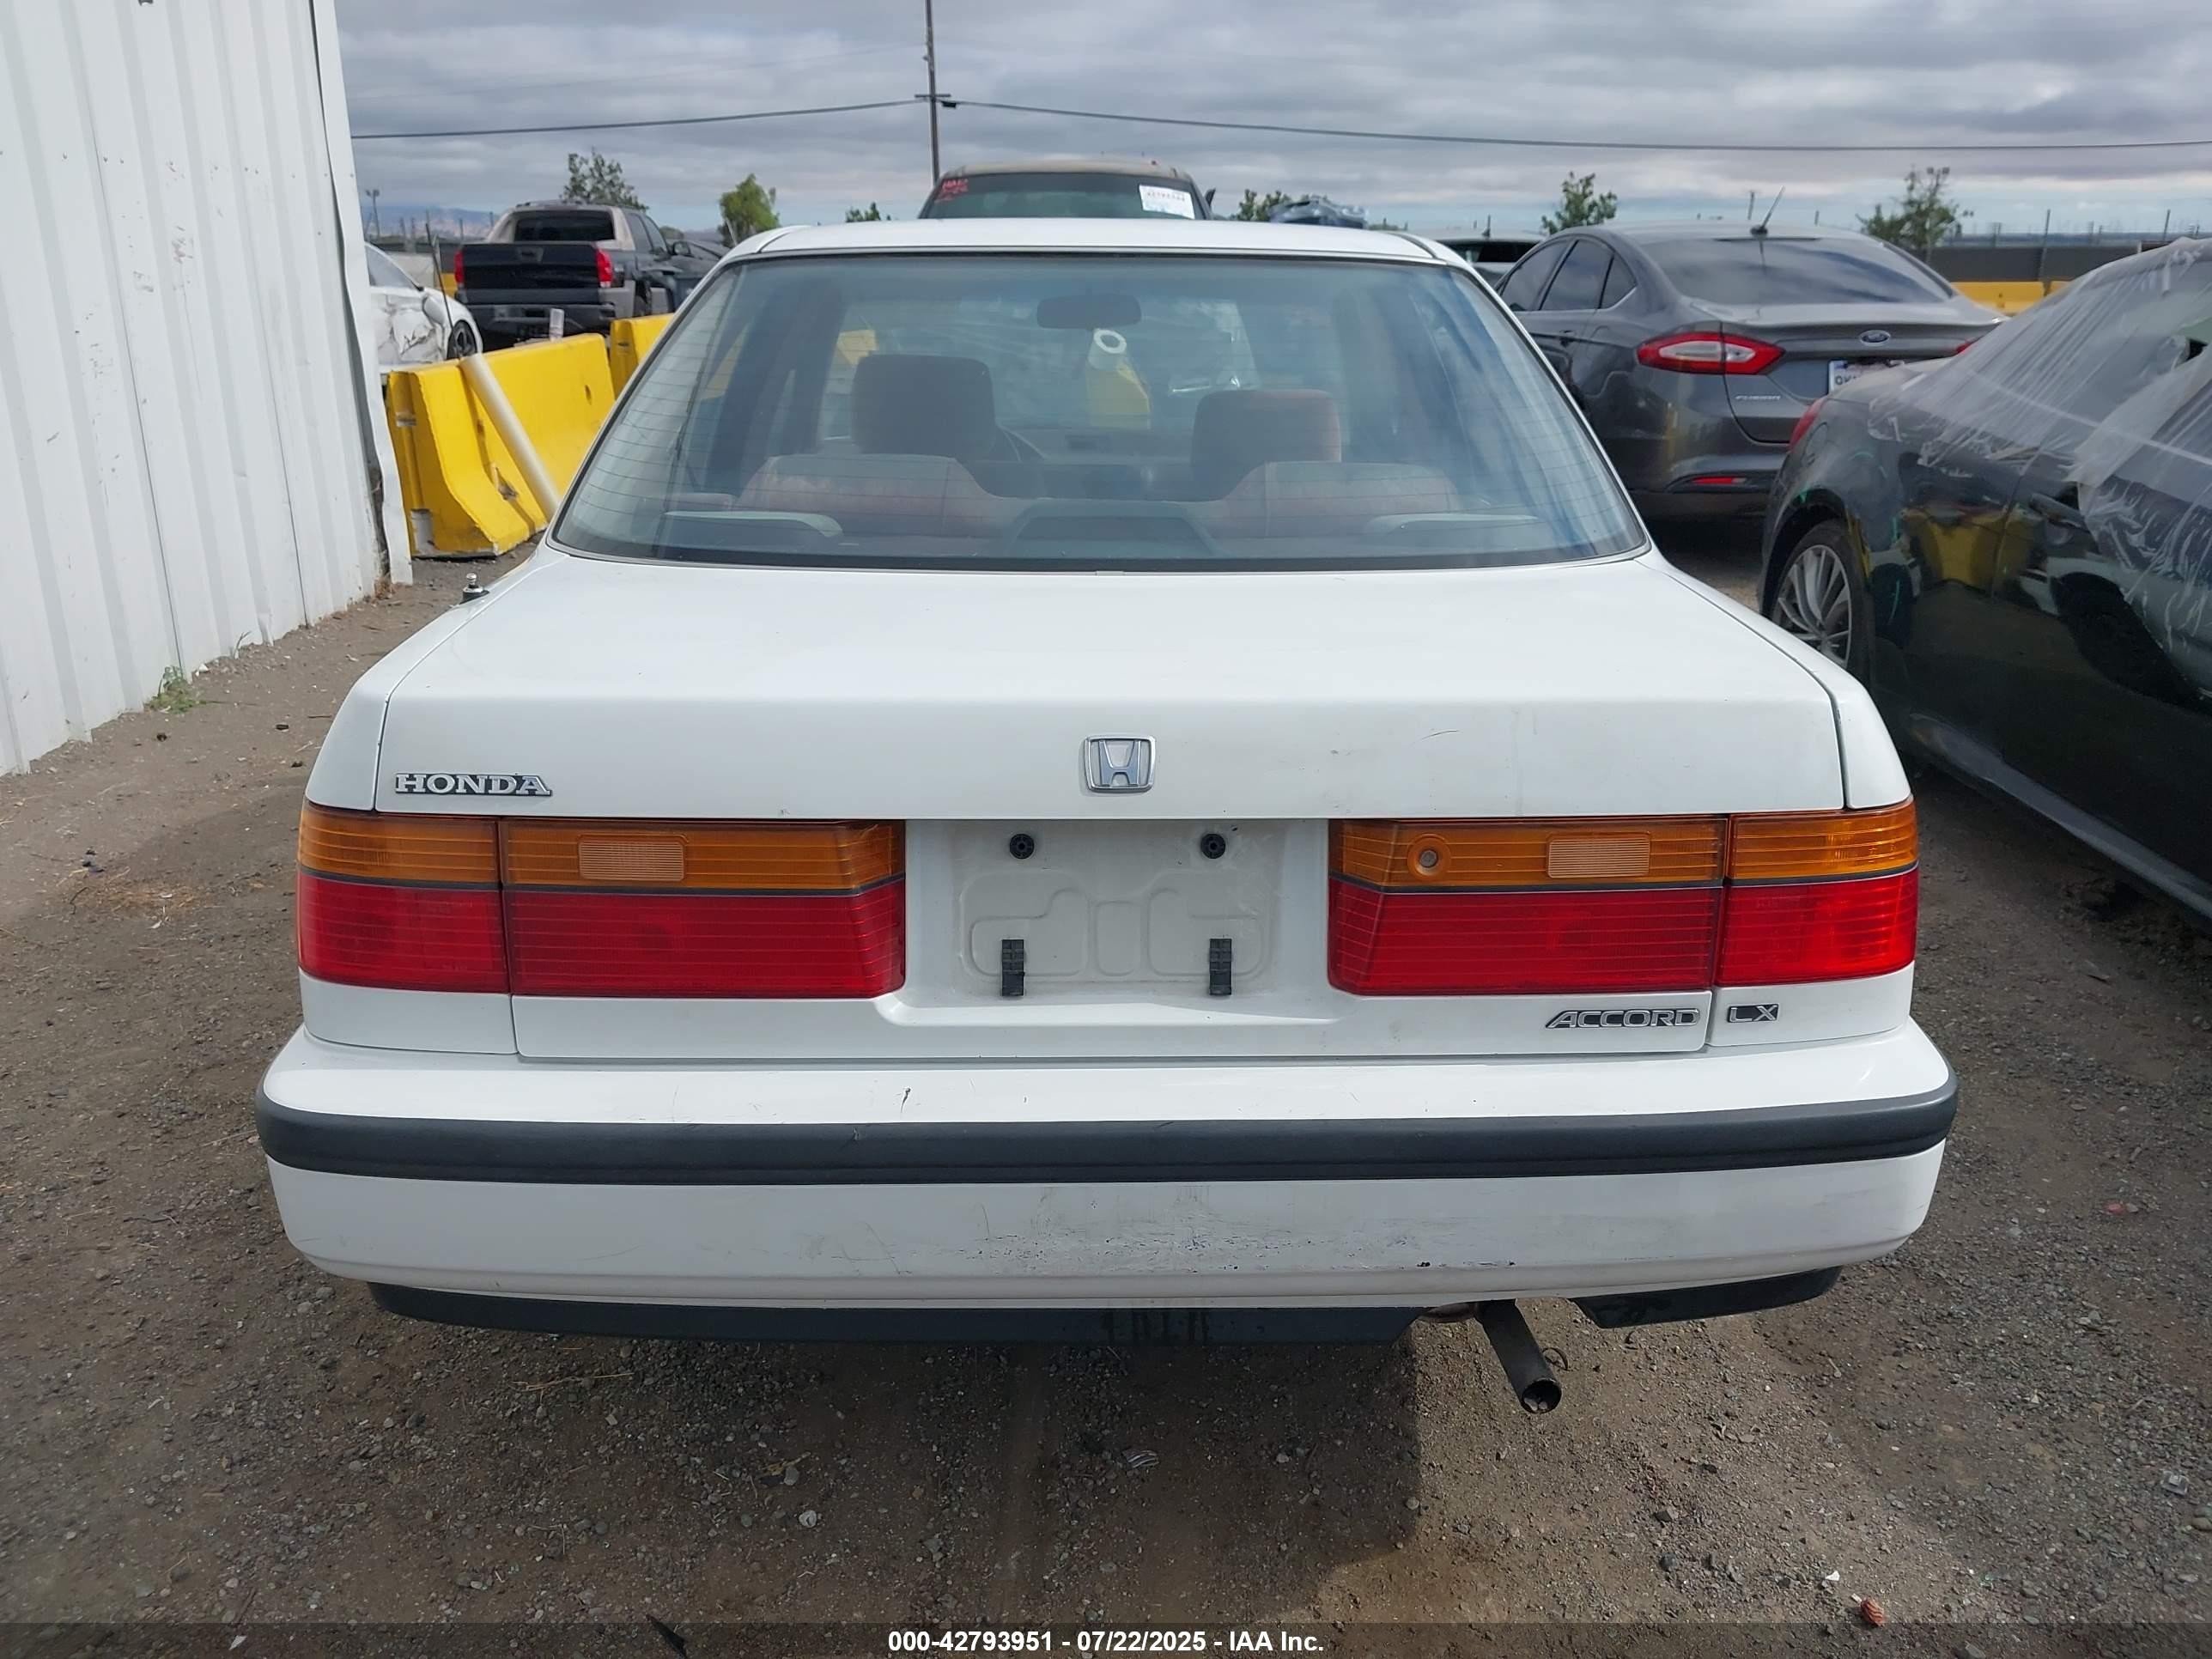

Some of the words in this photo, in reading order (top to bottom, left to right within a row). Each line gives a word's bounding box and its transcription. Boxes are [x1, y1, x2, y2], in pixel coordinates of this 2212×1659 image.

[396, 774, 551, 796] HONDA
[1546, 1008, 1701, 1029] ACCORD
[1728, 1004, 1779, 1024] LX
